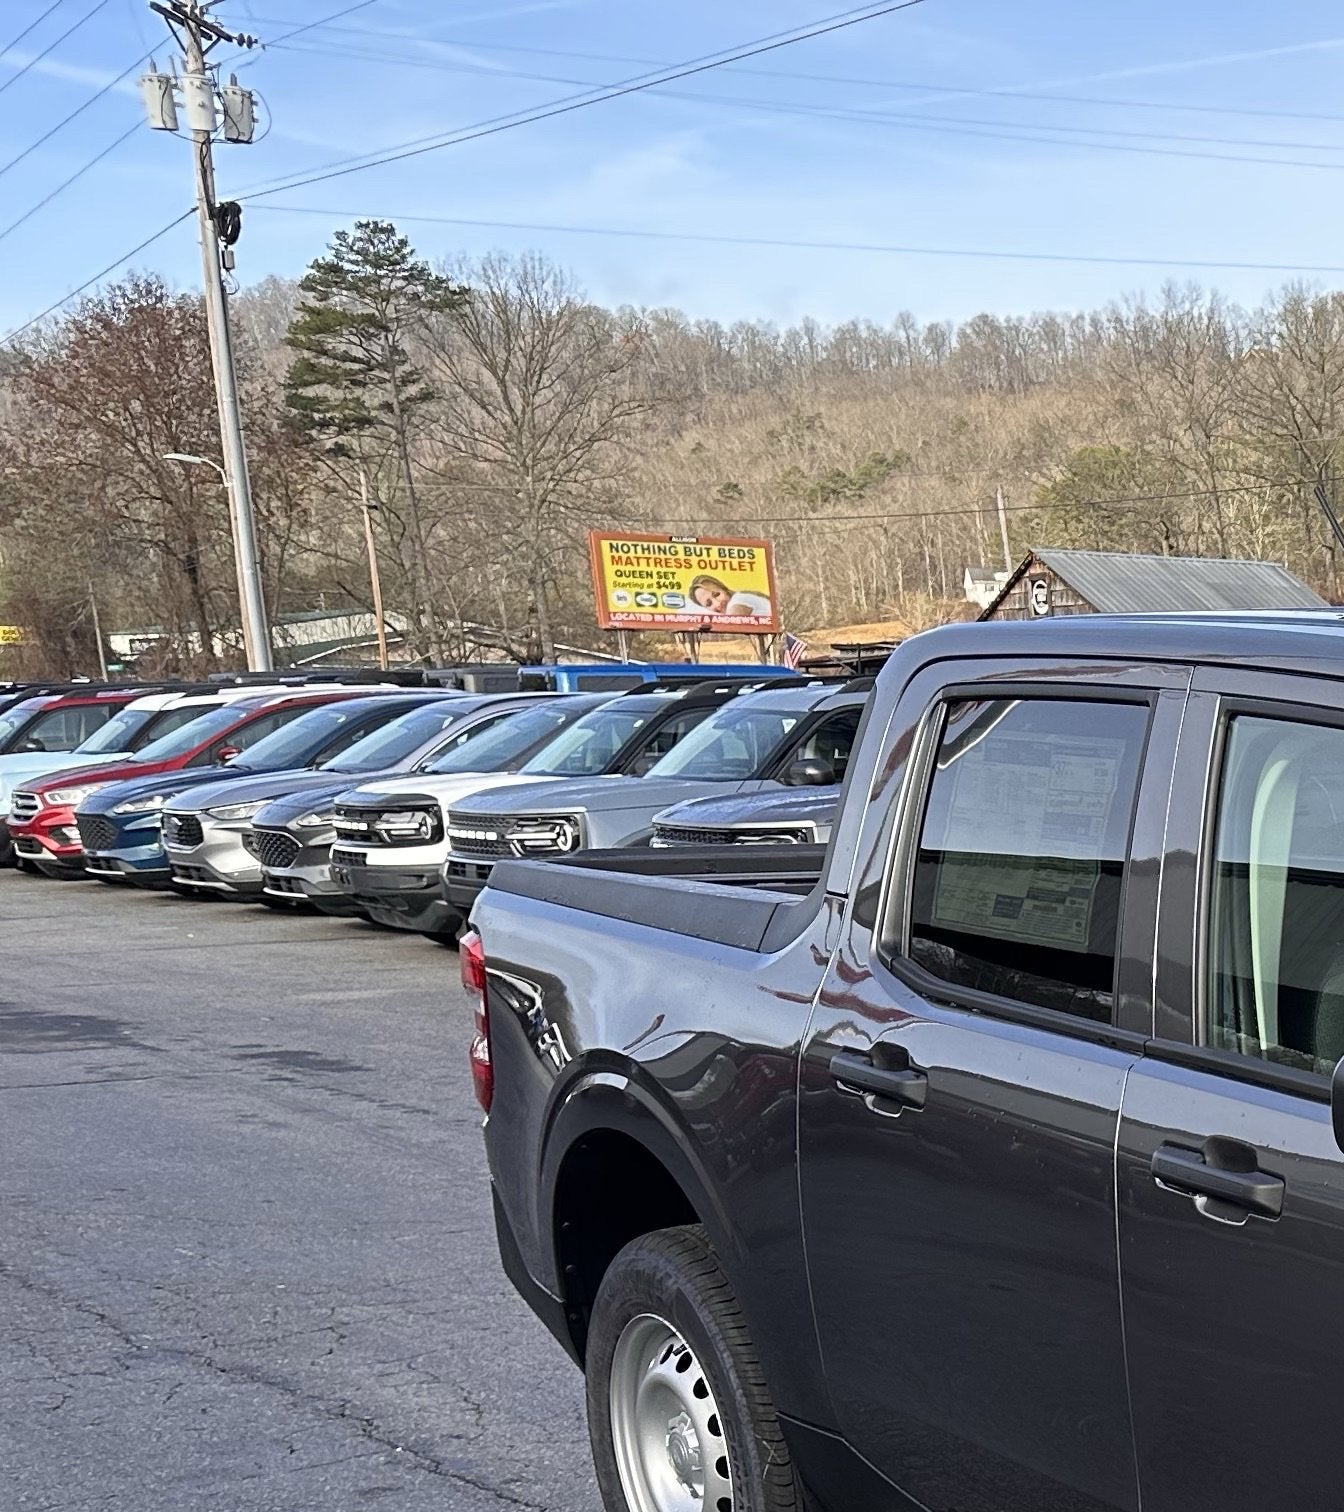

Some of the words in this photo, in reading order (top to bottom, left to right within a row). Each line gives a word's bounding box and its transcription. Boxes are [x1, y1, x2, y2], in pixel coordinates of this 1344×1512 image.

[609, 542, 679, 556] NOTHING
[684, 546, 712, 558] BUT
[718, 547, 756, 560] BEDS
[610, 555, 693, 569] MATTRESS
[697, 559, 756, 572] OUTLET
[614, 569, 654, 580] QUEEN
[656, 571, 677, 581] SET
[612, 580, 645, 590] Starting
[655, 581, 682, 591] $499
[610, 613, 653, 622] LOCATED
[653, 614, 665, 622] IN
[665, 614, 703, 624] MURPHY
